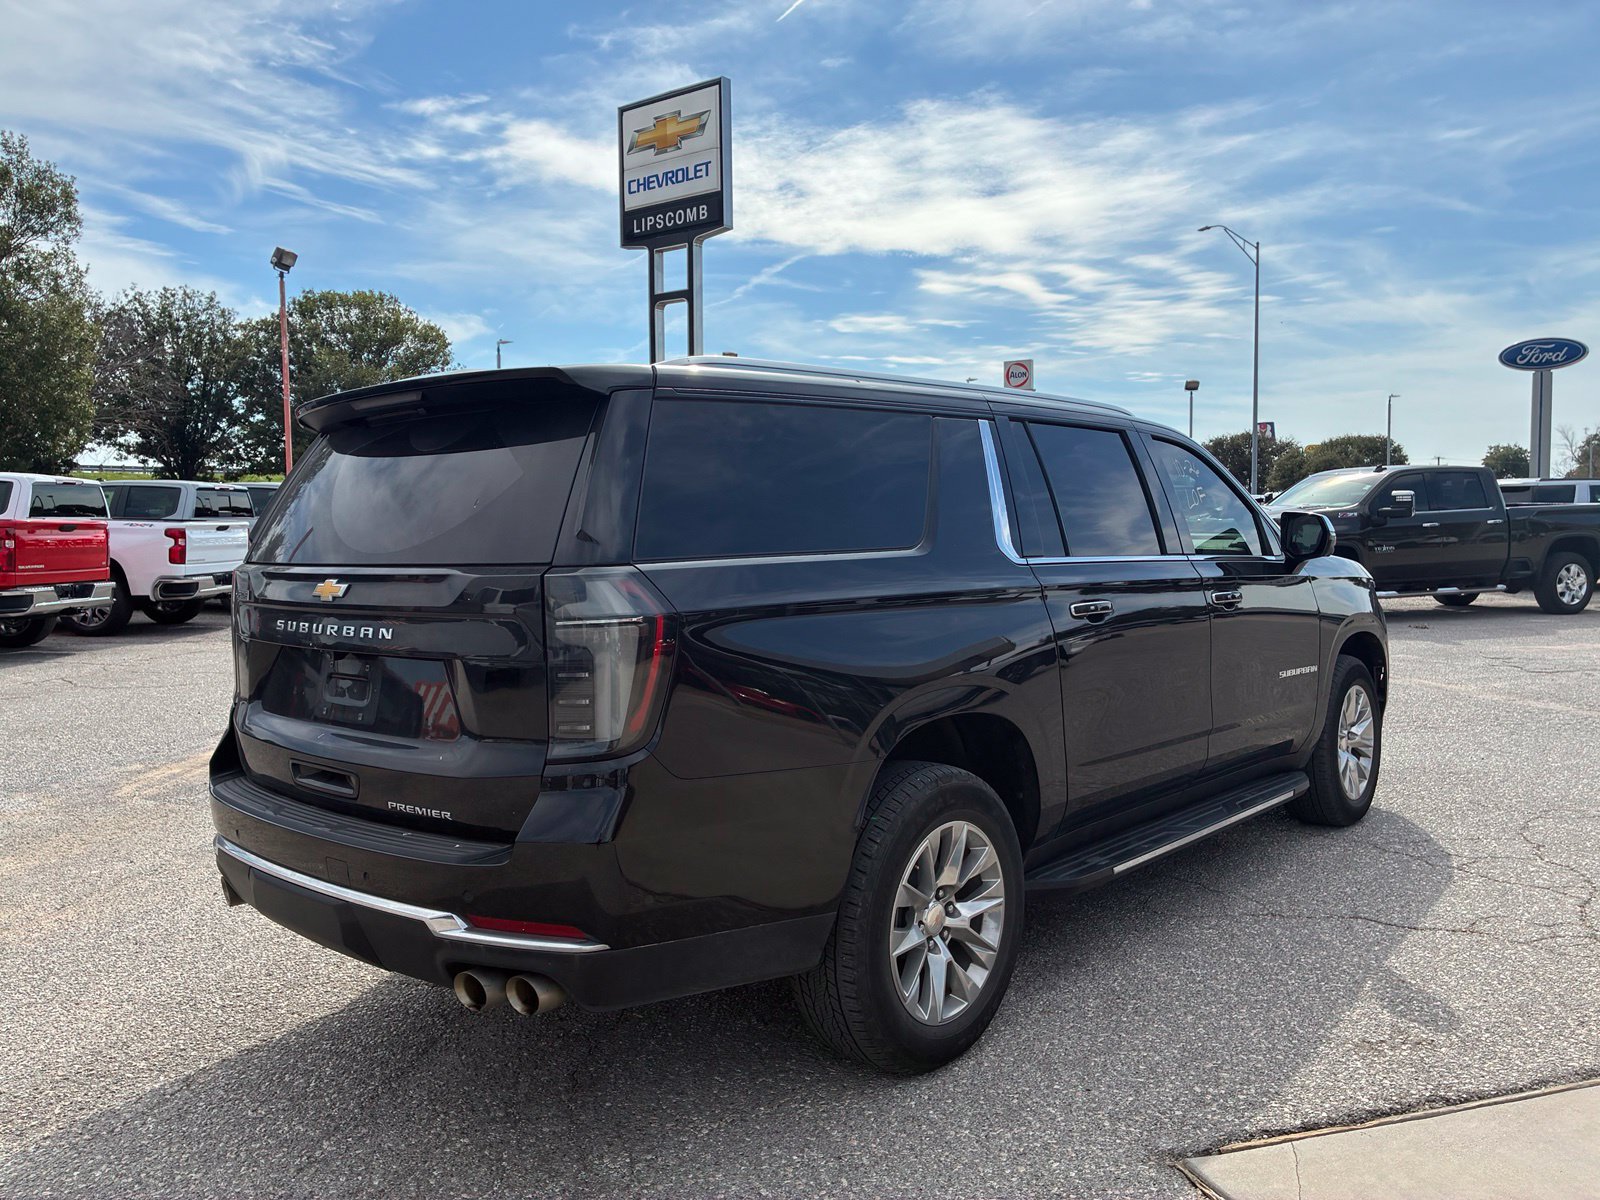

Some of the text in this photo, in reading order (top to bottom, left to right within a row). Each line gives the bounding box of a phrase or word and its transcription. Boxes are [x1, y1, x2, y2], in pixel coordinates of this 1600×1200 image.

[628, 161, 711, 195] CHEVROLET
[633, 204, 708, 233] LIPSCOMB
[1516, 344, 1568, 365] Ford
[1010, 370, 1027, 379] ALON
[275, 619, 395, 641] SUBURBAN
[1279, 665, 1318, 679] SUBURBAN
[387, 801, 453, 821] PREMIER
